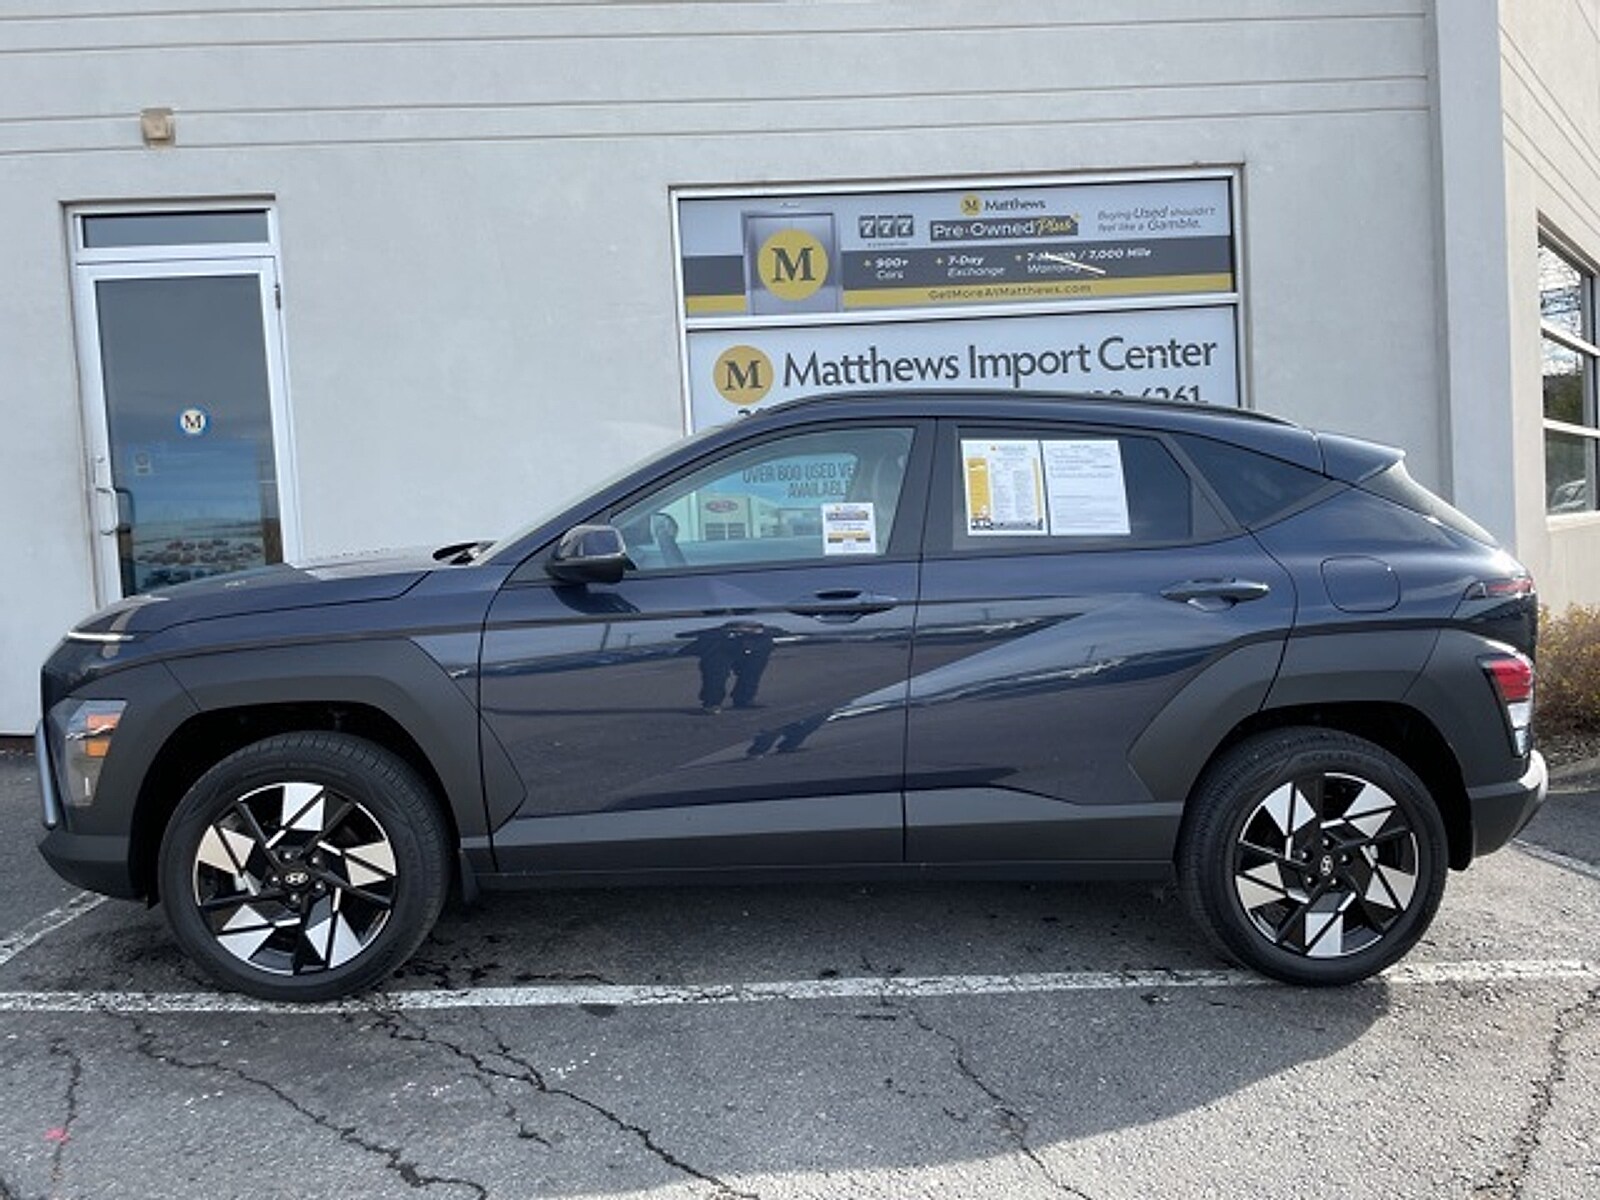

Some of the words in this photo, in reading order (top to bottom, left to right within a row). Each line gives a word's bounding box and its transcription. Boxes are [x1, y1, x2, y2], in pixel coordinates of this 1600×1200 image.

[984, 198, 1046, 211] Matthews
[1133, 205, 1168, 219] Used
[1088, 247, 1124, 260] 7,000
[772, 247, 816, 283] M
[947, 255, 984, 267] 7-Day
[947, 265, 1005, 278] Exchange
[927, 282, 1092, 301] GetMoreAtMatthews.com
[783, 346, 960, 388] Matthews
[968, 344, 1091, 388] Import
[1099, 336, 1218, 371] Center
[724, 360, 764, 391] M
[184, 404, 202, 418] M
[743, 464, 777, 483] OVER
[805, 462, 837, 480] USED
